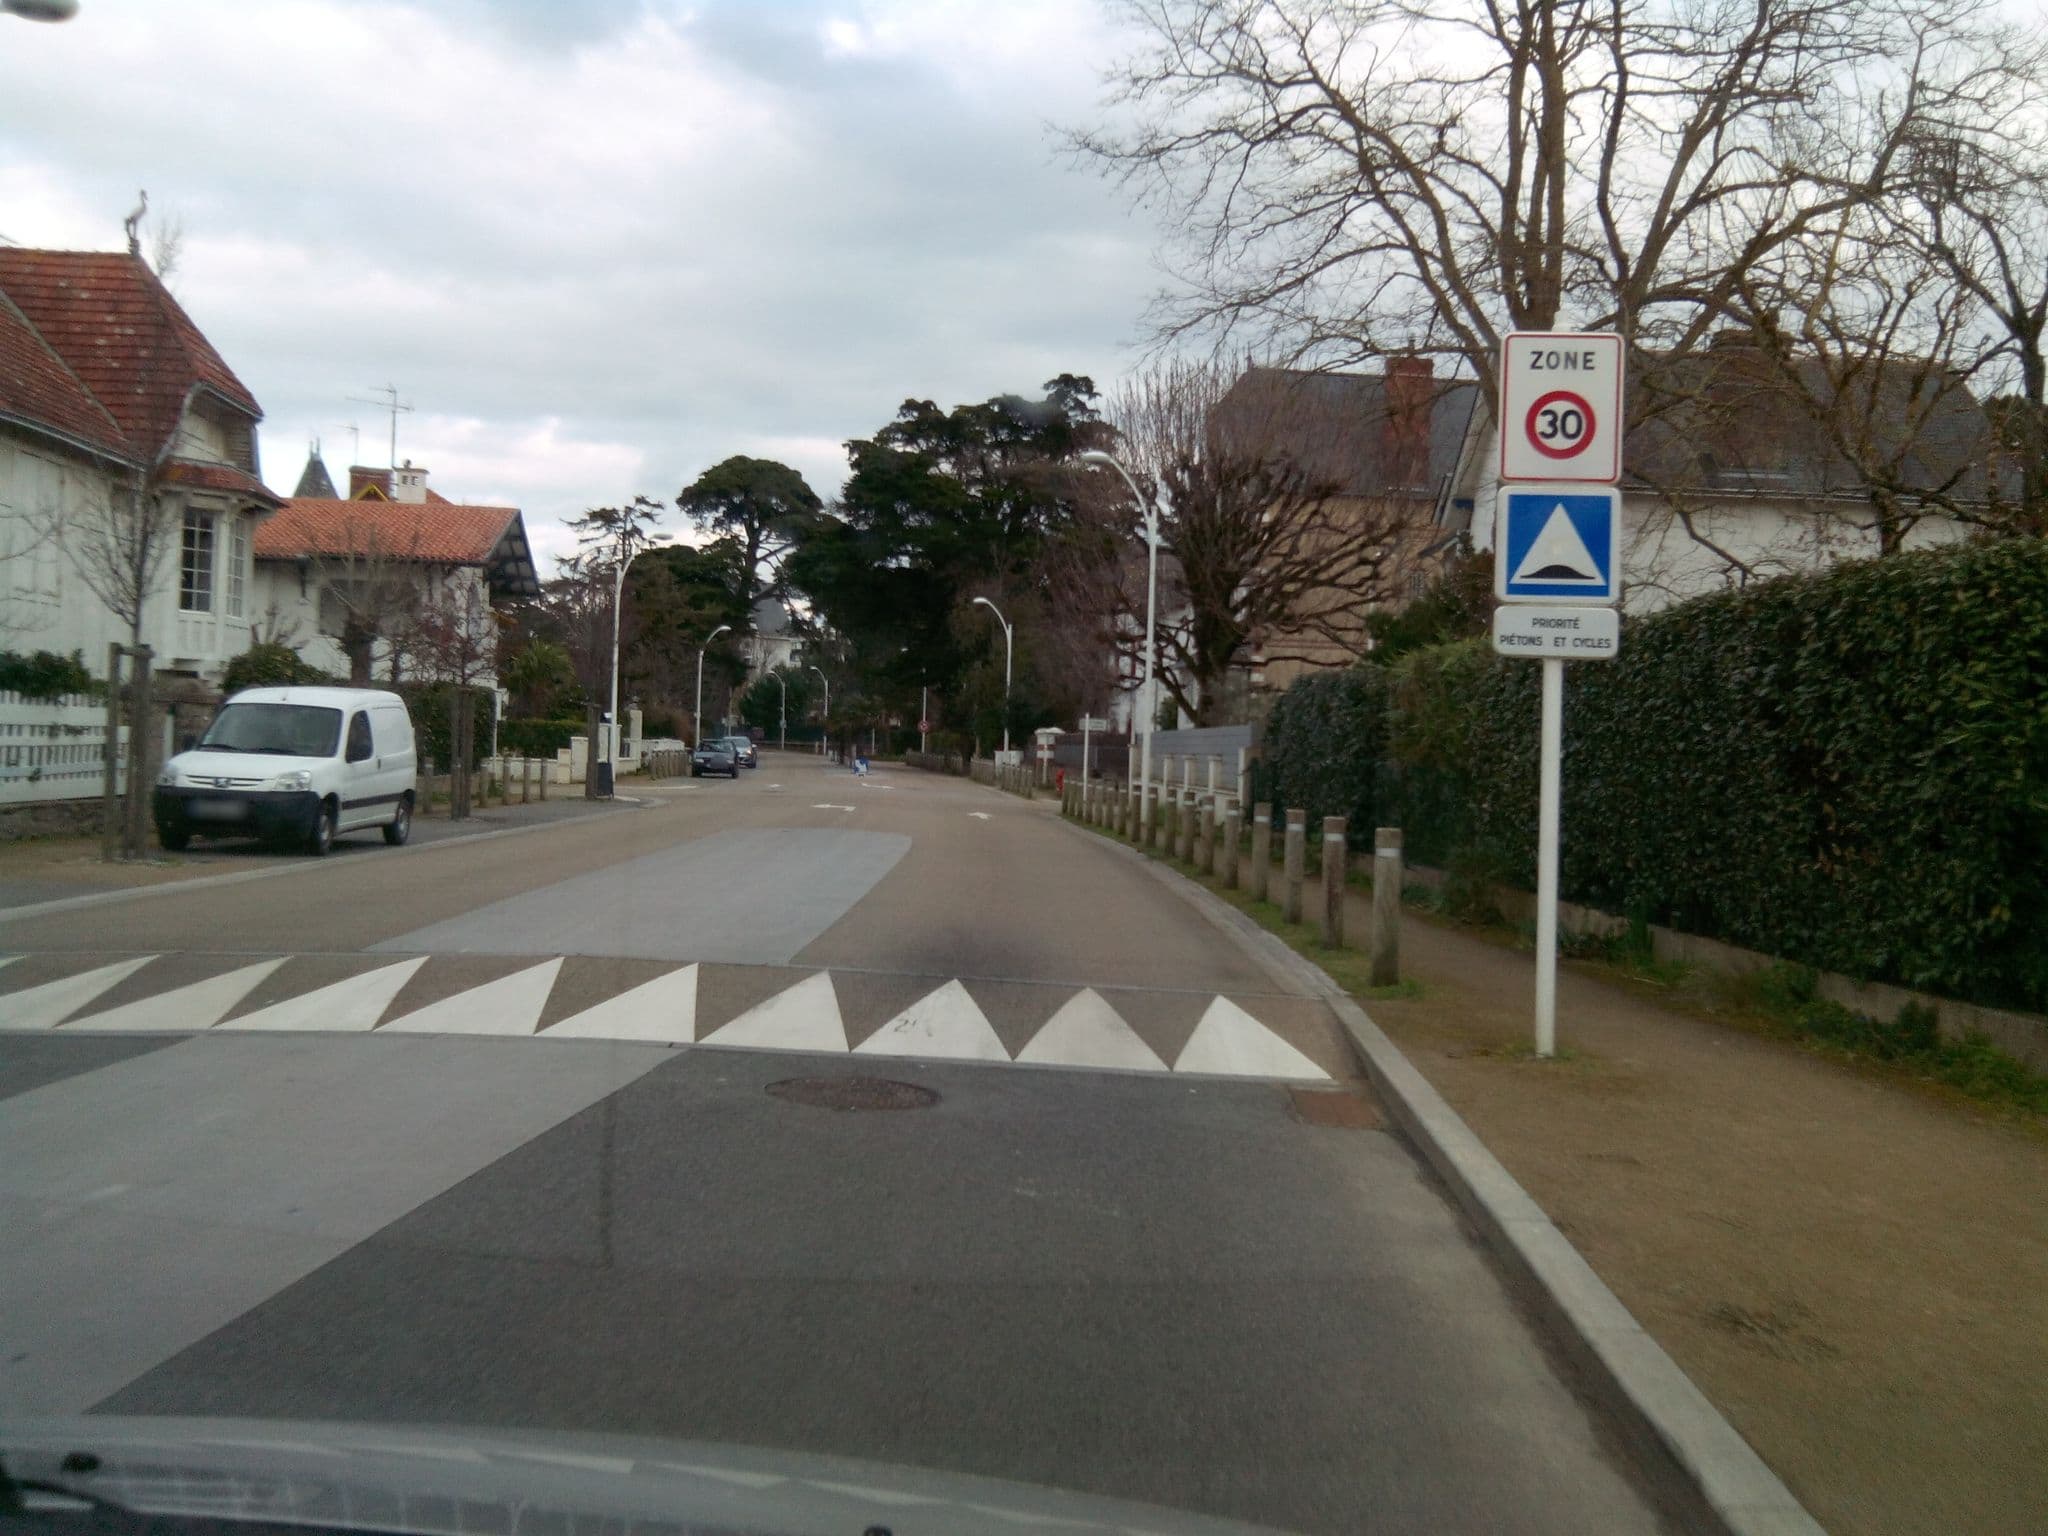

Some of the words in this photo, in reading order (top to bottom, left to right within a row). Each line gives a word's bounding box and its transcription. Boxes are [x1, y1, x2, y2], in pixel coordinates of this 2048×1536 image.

[1530, 351, 1595, 370] ZONE
[1538, 409, 1583, 440] 30
[1532, 617, 1580, 629] PRIORITÉ
[1500, 633, 1542, 646] PIÉTONS
[1554, 637, 1566, 647] ET
[1572, 638, 1611, 648] CYCLES
